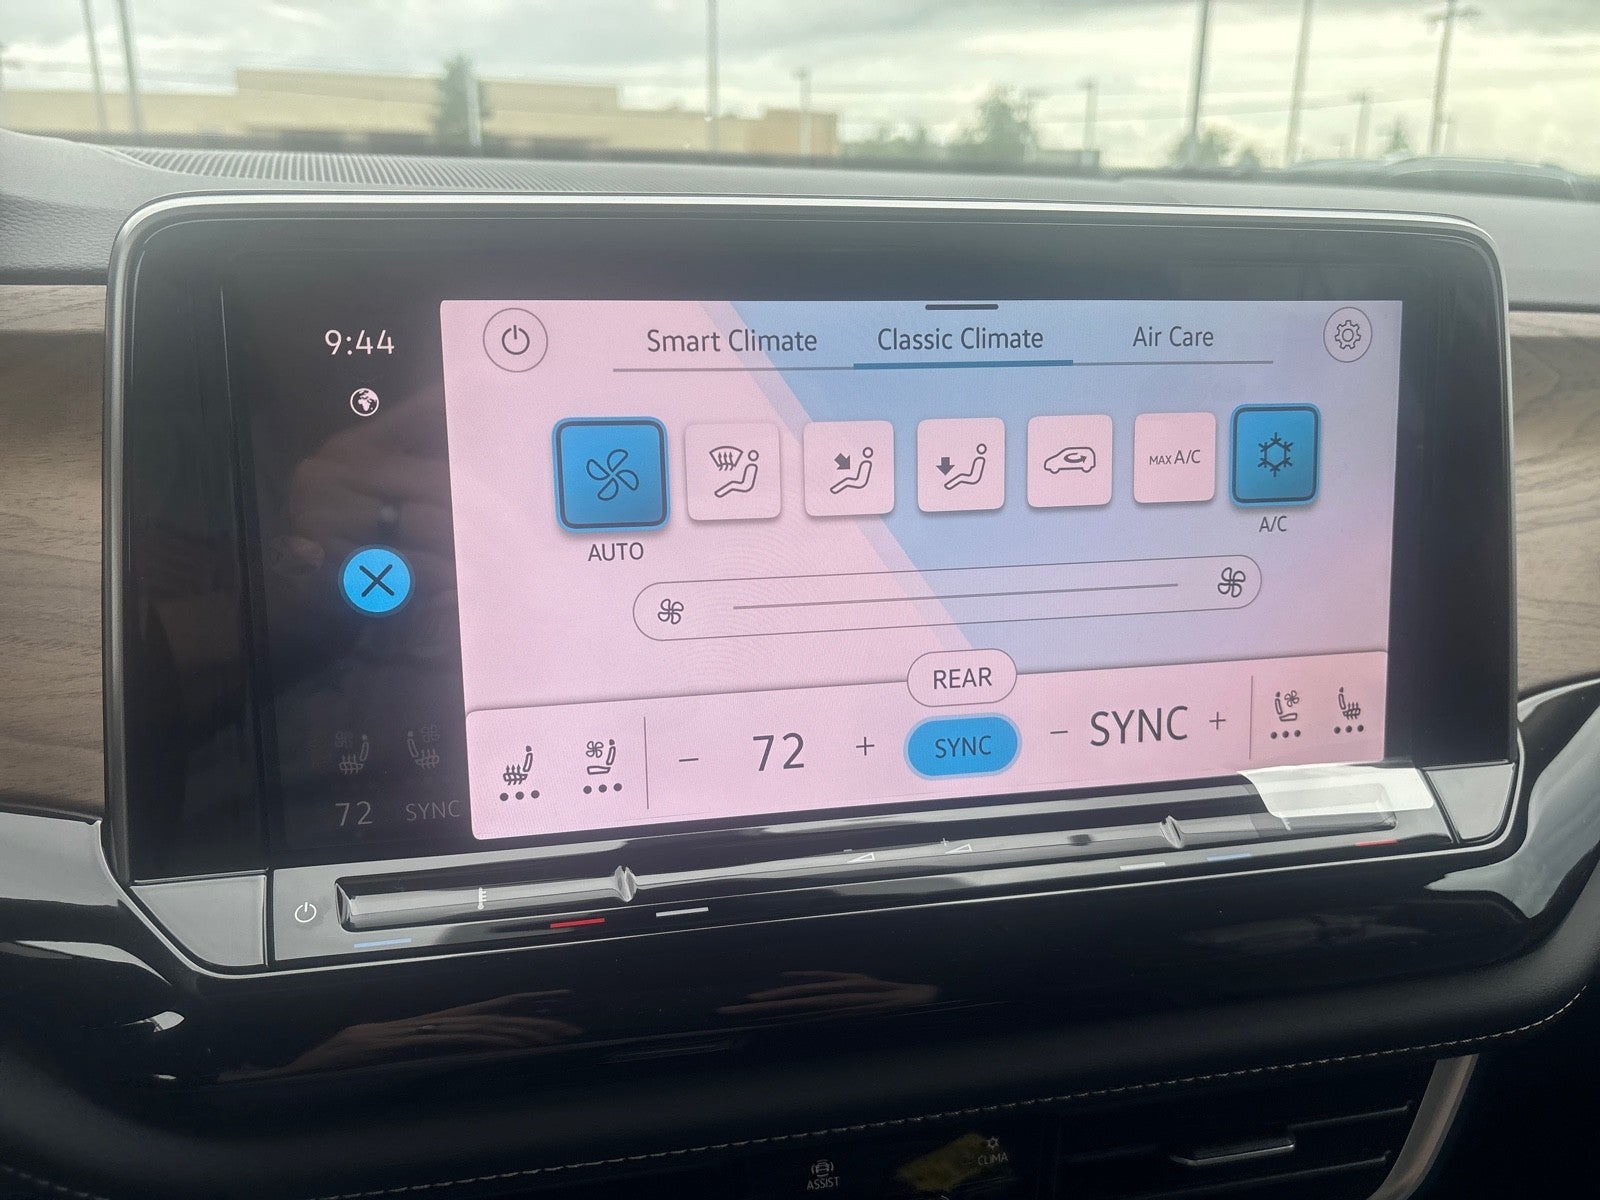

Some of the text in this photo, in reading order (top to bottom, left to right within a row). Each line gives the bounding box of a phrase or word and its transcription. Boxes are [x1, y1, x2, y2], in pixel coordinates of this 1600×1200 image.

[324, 329, 395, 356] 9:44
[646, 328, 819, 353] Smart Climate
[877, 326, 1045, 351] Classic Climate
[1132, 325, 1215, 348] Air Care
[1149, 448, 1201, 466] MAX A/C
[1259, 515, 1288, 534] A/C
[588, 542, 644, 562] AUTO
[932, 667, 993, 690] REAR
[1090, 705, 1189, 748] SYNC
[752, 732, 806, 772] 72
[934, 735, 993, 760] SYNC
[335, 801, 374, 828] 72
[405, 799, 461, 822] SYNC
[977, 1152, 1009, 1165] CLIMA
[806, 1176, 840, 1190] ASSIST
